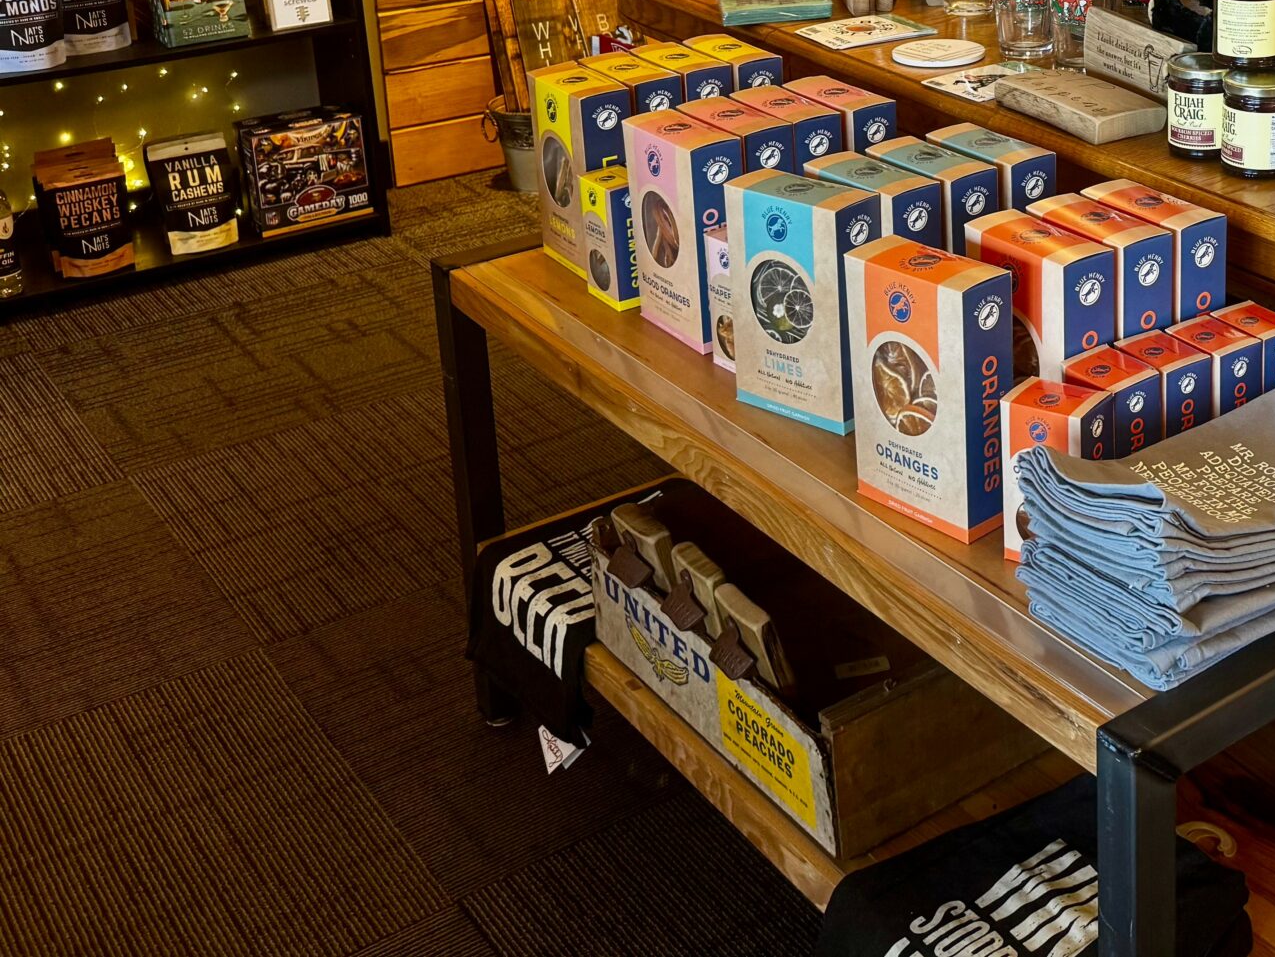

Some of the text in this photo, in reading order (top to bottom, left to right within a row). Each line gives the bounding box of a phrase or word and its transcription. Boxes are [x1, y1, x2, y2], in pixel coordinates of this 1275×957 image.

[1174, 94, 1205, 109] ELIJAH
[165, 155, 218, 172] VANILLA
[702, 156, 733, 172] BLUE HENRY
[168, 164, 223, 191] RUM
[56, 182, 117, 204] CINNAMON
[172, 182, 224, 201] CASHEWS
[57, 196, 118, 217] WHISKEY
[288, 193, 368, 219] GAMEDAY 1000
[60, 208, 120, 229] PECANS
[642, 272, 691, 309] BLOOD ORANGES
[973, 295, 1003, 317] BLUE HENRY
[764, 356, 803, 377] LIMES
[981, 355, 1000, 493] ORANGES
[888, 439, 923, 459] DEHYDRATED
[1230, 442, 1255, 463] MR.
[876, 443, 940, 481] ORANGES
[1227, 456, 1255, 477] DID
[1130, 461, 1241, 524] NEIGHBORHOOD
[1152, 461, 1252, 522] PEOPLE IN MY
[1172, 462, 1258, 515] ME FOR THE
[1196, 465, 1262, 505] PREPARE
[603, 571, 712, 684] UNITED
[728, 700, 794, 765] COLORADO
[736, 721, 792, 779] PEACHES
